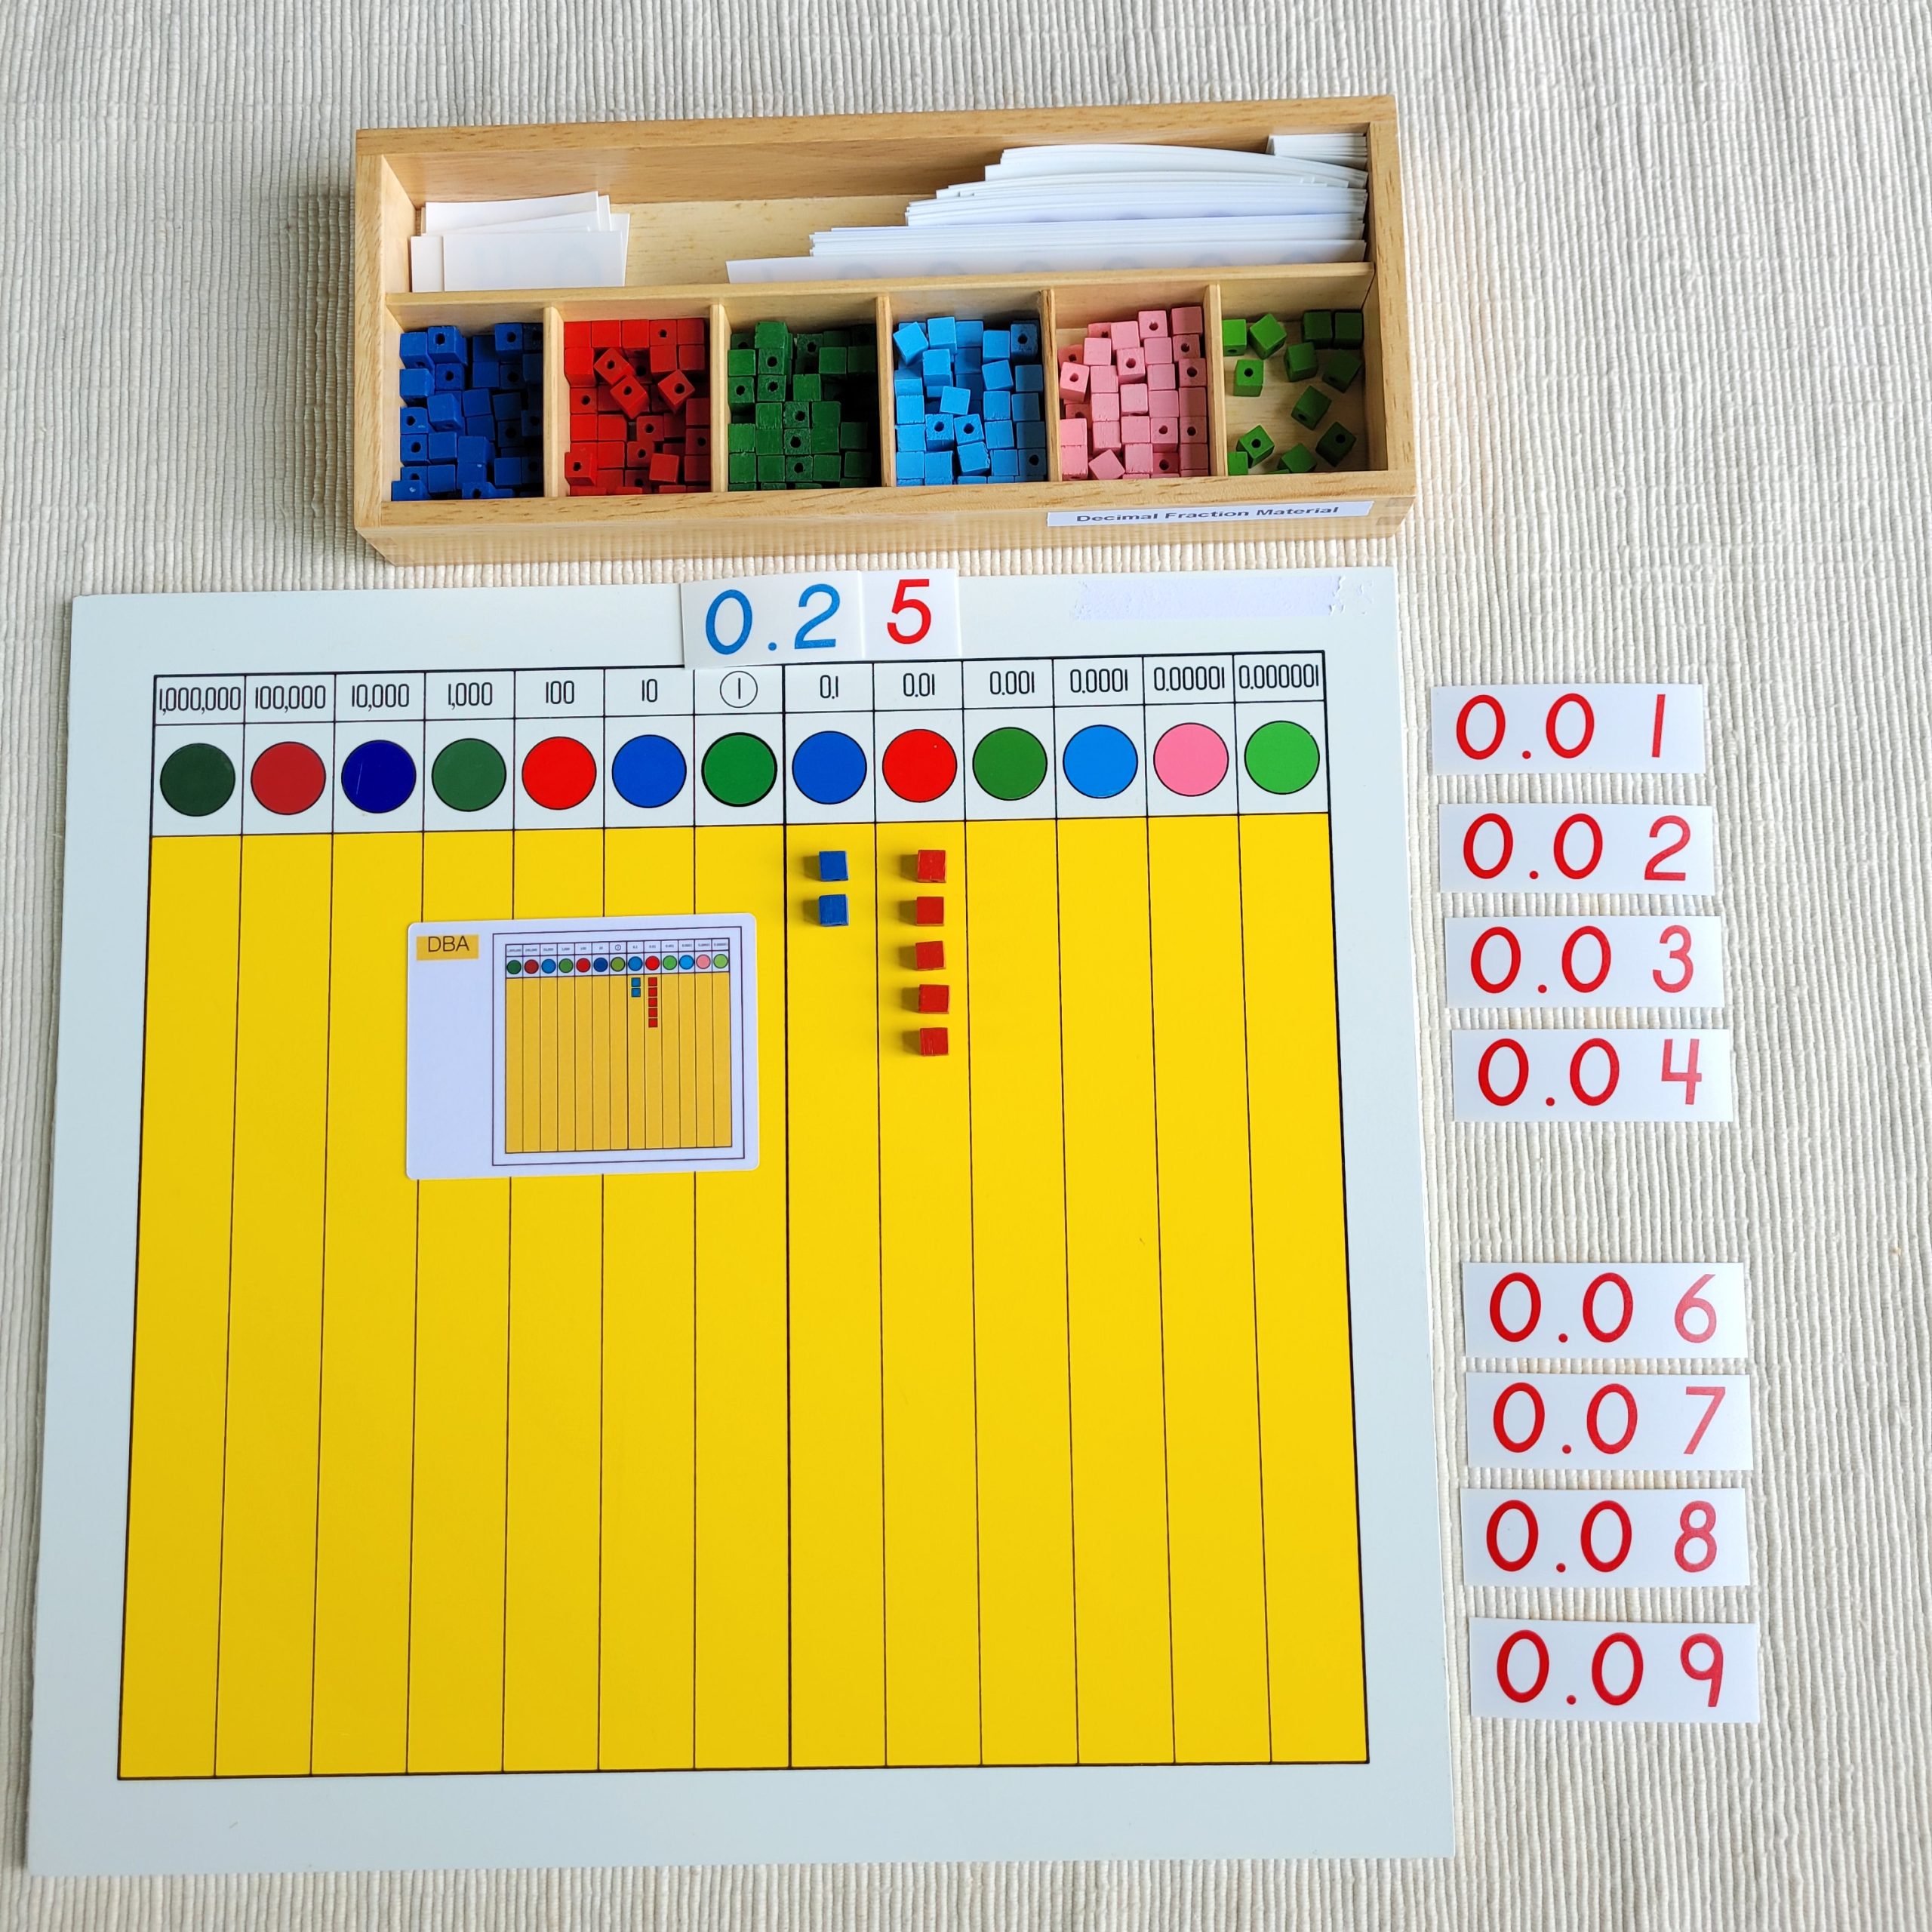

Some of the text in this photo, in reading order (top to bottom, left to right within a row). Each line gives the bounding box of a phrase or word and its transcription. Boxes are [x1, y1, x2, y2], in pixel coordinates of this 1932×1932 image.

[1076, 506, 1339, 522] Decimal Fraction Material
[820, 675, 838, 700] 0.1
[903, 672, 935, 697] 0.01
[989, 670, 1035, 696] 0.001
[1069, 668, 1128, 694] 0.0001
[1153, 666, 1225, 692] 0.00001
[1238, 663, 1319, 690] 0.000001
[158, 686, 242, 714] 1,000,000
[255, 685, 326, 712] 100,000
[352, 683, 410, 711] 10,000
[448, 681, 493, 709] 1,000
[546, 680, 575, 705] 100
[641, 678, 658, 703] 10
[428, 935, 469, 952] DBA
